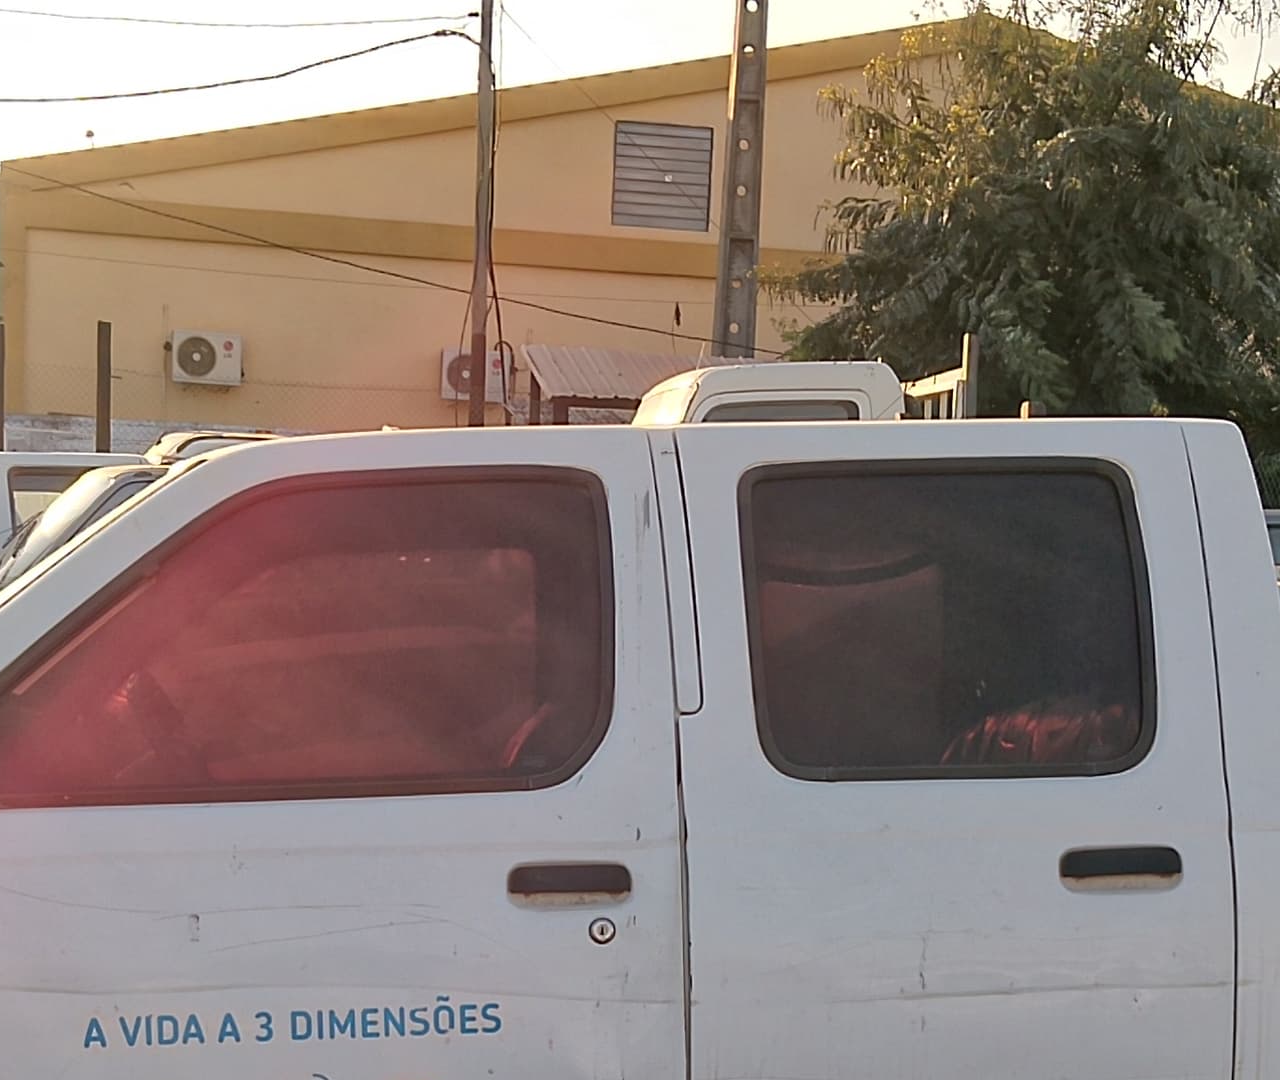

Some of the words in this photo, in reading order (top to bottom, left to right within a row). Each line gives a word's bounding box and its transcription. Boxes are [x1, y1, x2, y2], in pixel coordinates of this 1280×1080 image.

[83, 1016, 107, 1049] A
[118, 1013, 205, 1047] VIDA
[218, 1012, 241, 1043] A
[255, 1011, 274, 1043] 3
[290, 995, 502, 1042] DIMENSÕES
